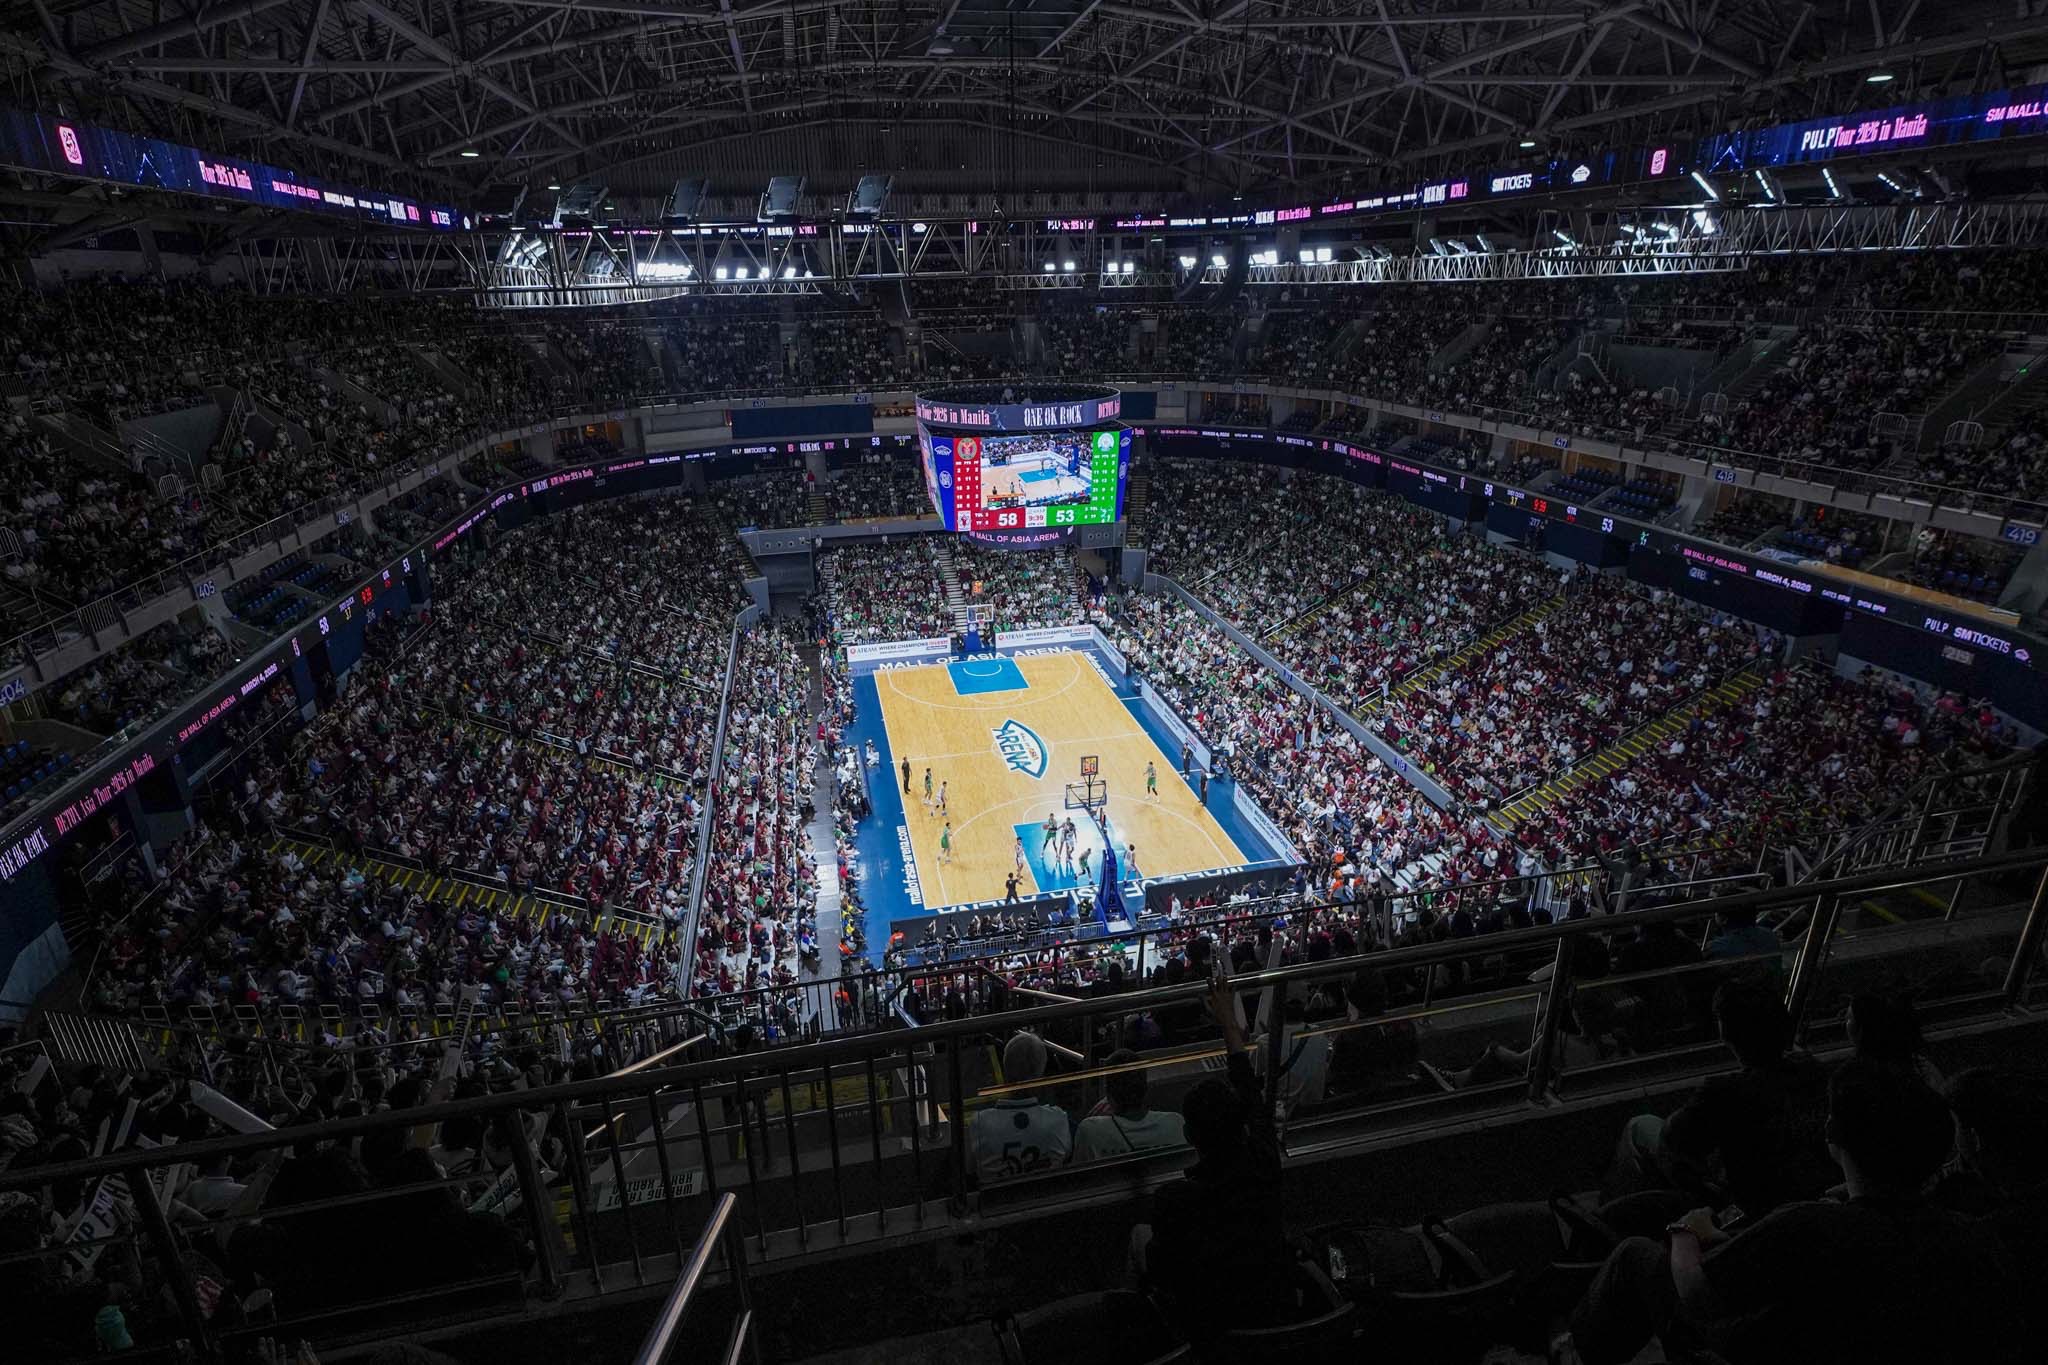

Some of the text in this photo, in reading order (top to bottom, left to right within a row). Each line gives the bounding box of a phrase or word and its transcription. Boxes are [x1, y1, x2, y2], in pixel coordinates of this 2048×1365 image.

[1986, 103, 2040, 122] SM MALL
[1801, 127, 1835, 151] PULP
[949, 409, 958, 424] in
[960, 409, 990, 425] Manila
[1024, 405, 1083, 427] ONE OK ROCK
[1716, 470, 1735, 482] 418
[1483, 482, 1494, 497] 58
[998, 512, 1018, 526] 58
[1056, 509, 1075, 522] 53
[1601, 518, 1613, 533] 53
[976, 531, 995, 544] MALL
[996, 535, 1008, 544] OF
[1010, 534, 1031, 544] ASIA
[1033, 531, 1060, 541] ARENA
[2007, 528, 2036, 544] 419
[1706, 554, 1714, 563] OF
[1755, 569, 1782, 584] MARCH
[1782, 577, 1790, 588] 4,
[199, 580, 216, 599] 405
[318, 615, 330, 635] 58
[1924, 617, 2012, 654] PULP SMTICKETS
[879, 645, 1073, 670] MALL OF ASIA ARENA
[187, 720, 204, 735] MALL
[201, 713, 209, 724] OF
[93, 785, 113, 807] Tour
[896, 824, 923, 905] mallofasia-arena.com
